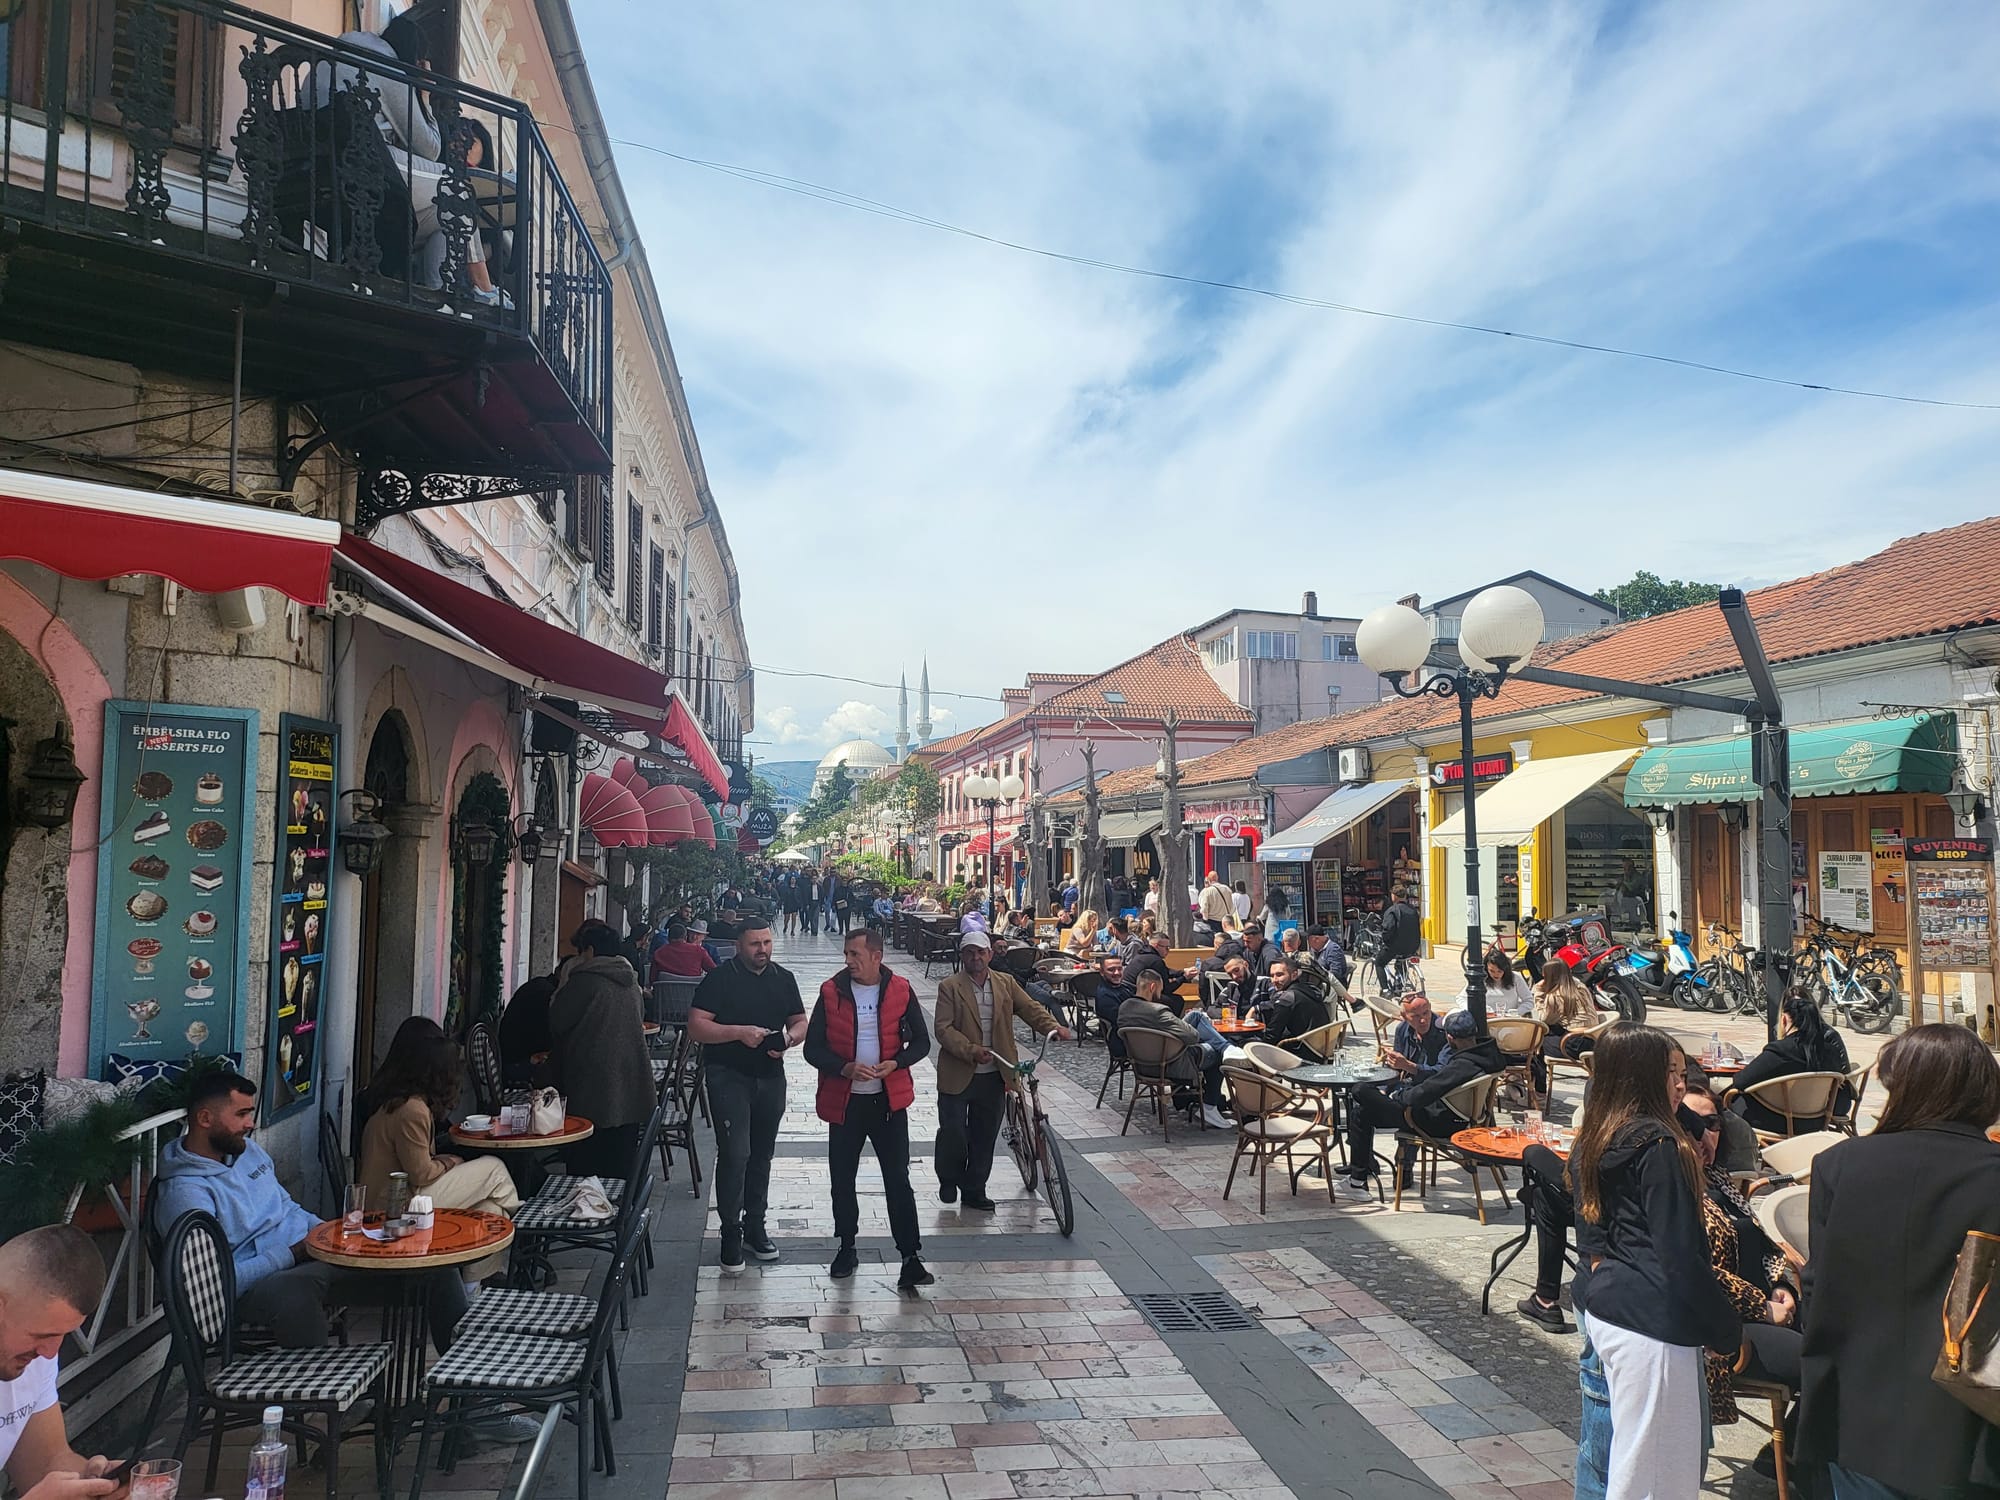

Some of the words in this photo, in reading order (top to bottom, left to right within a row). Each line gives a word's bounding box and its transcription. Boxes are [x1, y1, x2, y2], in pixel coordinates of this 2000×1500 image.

[149, 735, 169, 745] NEW
[207, 730, 231, 740] FLO
[201, 744, 225, 754] FLO
[1740, 774, 1748, 785] e
[1912, 840, 1988, 854] SUVENIRE
[1936, 850, 1968, 859] SHOP
